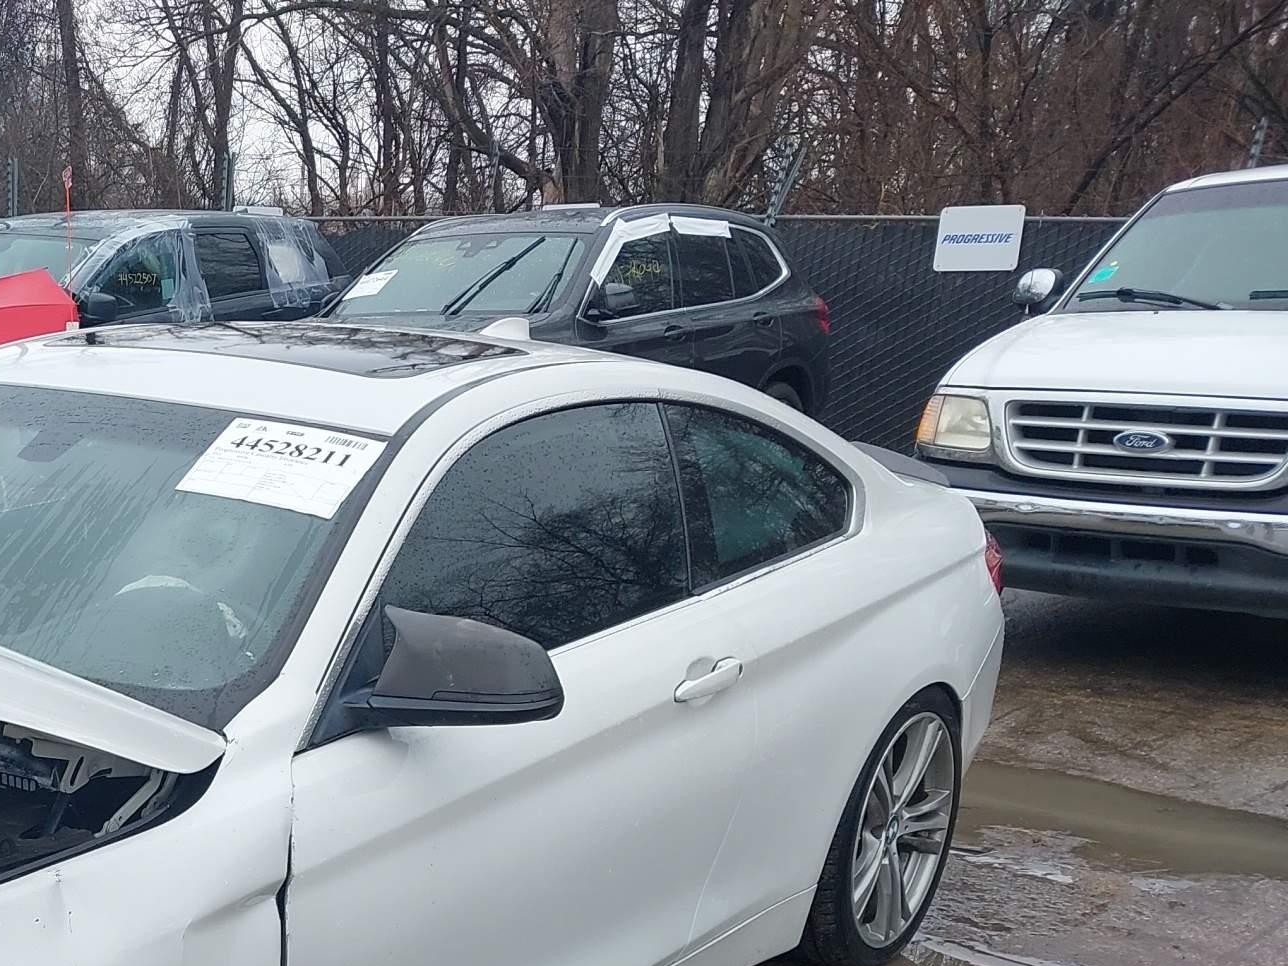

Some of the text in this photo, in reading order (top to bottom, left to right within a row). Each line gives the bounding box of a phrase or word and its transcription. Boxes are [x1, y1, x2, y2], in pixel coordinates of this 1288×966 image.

[941, 233, 1014, 245] PROGRESSIVE
[1125, 434, 1158, 448] Ford
[230, 435, 353, 468] 44528211
